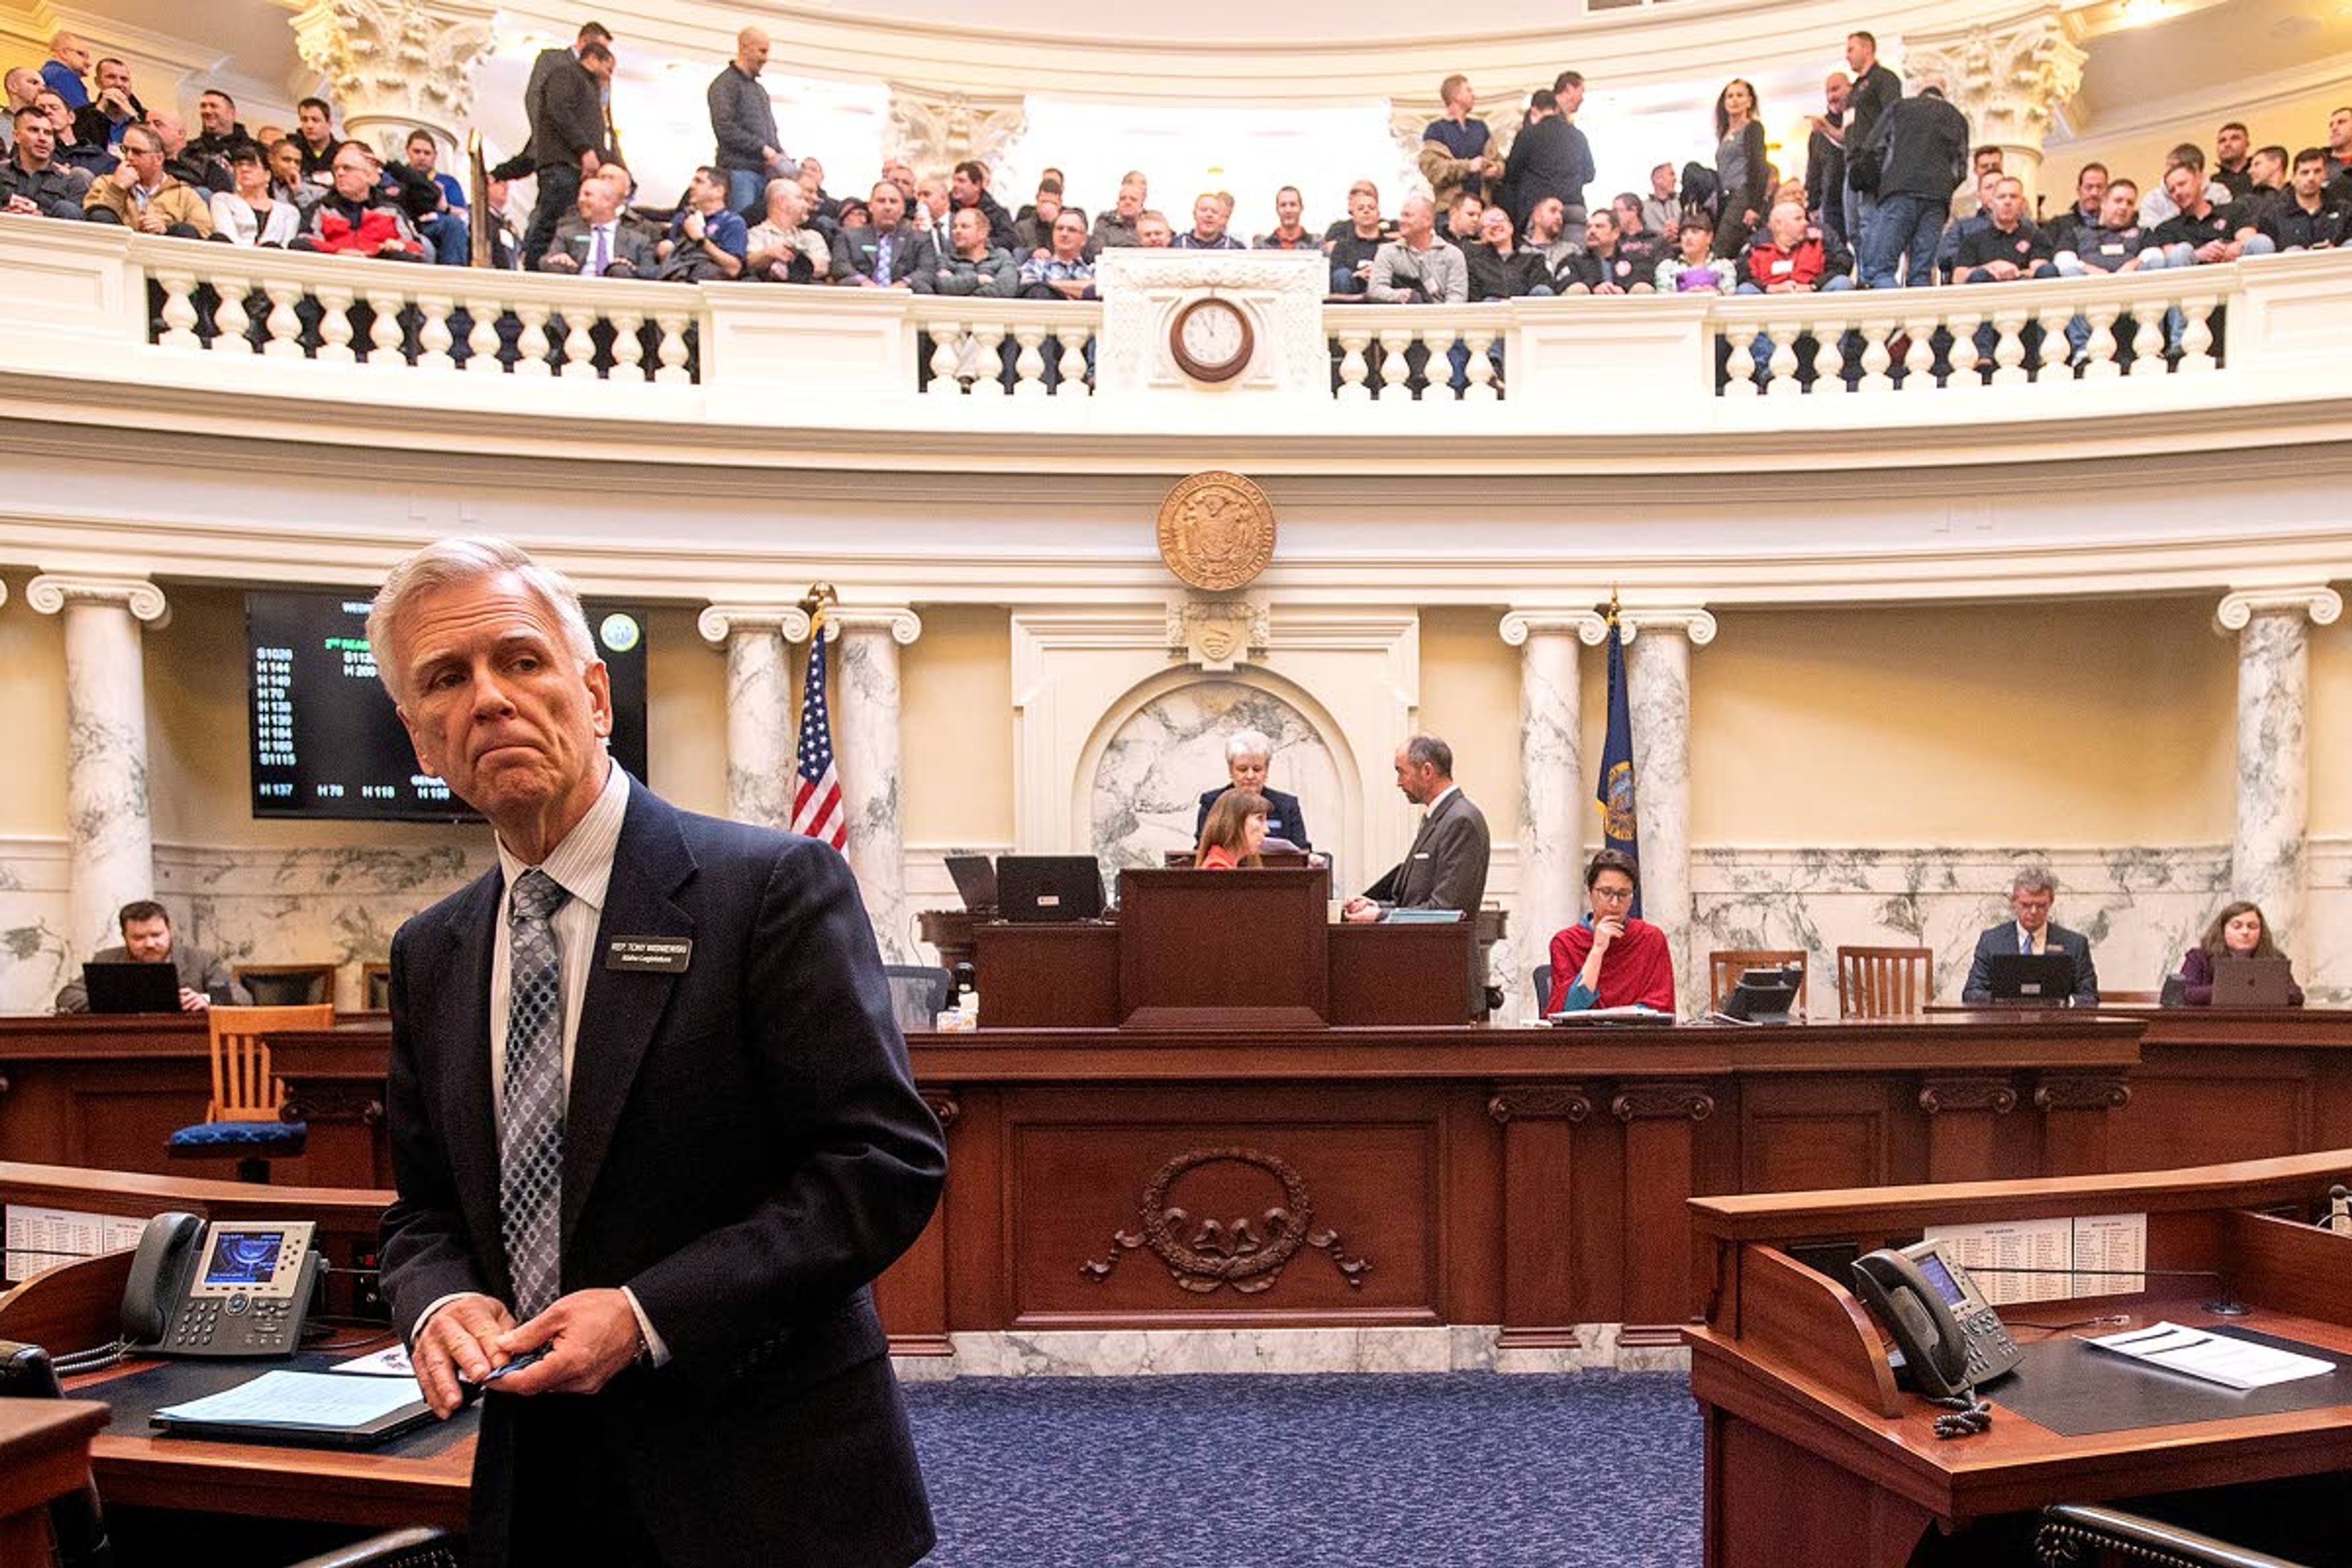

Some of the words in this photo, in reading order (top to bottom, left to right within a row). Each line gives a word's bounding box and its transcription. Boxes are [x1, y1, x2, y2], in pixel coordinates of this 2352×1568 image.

[257, 661, 268, 673] H
[344, 665, 353, 677] H
[257, 674, 268, 685] H
[258, 688, 268, 698] H
[258, 701, 269, 712] H
[258, 714, 269, 725] H
[258, 728, 269, 739] H
[259, 741, 270, 752] H
[260, 784, 271, 795] H
[317, 784, 328, 796] H
[362, 786, 373, 798] H
[417, 788, 428, 799] H
